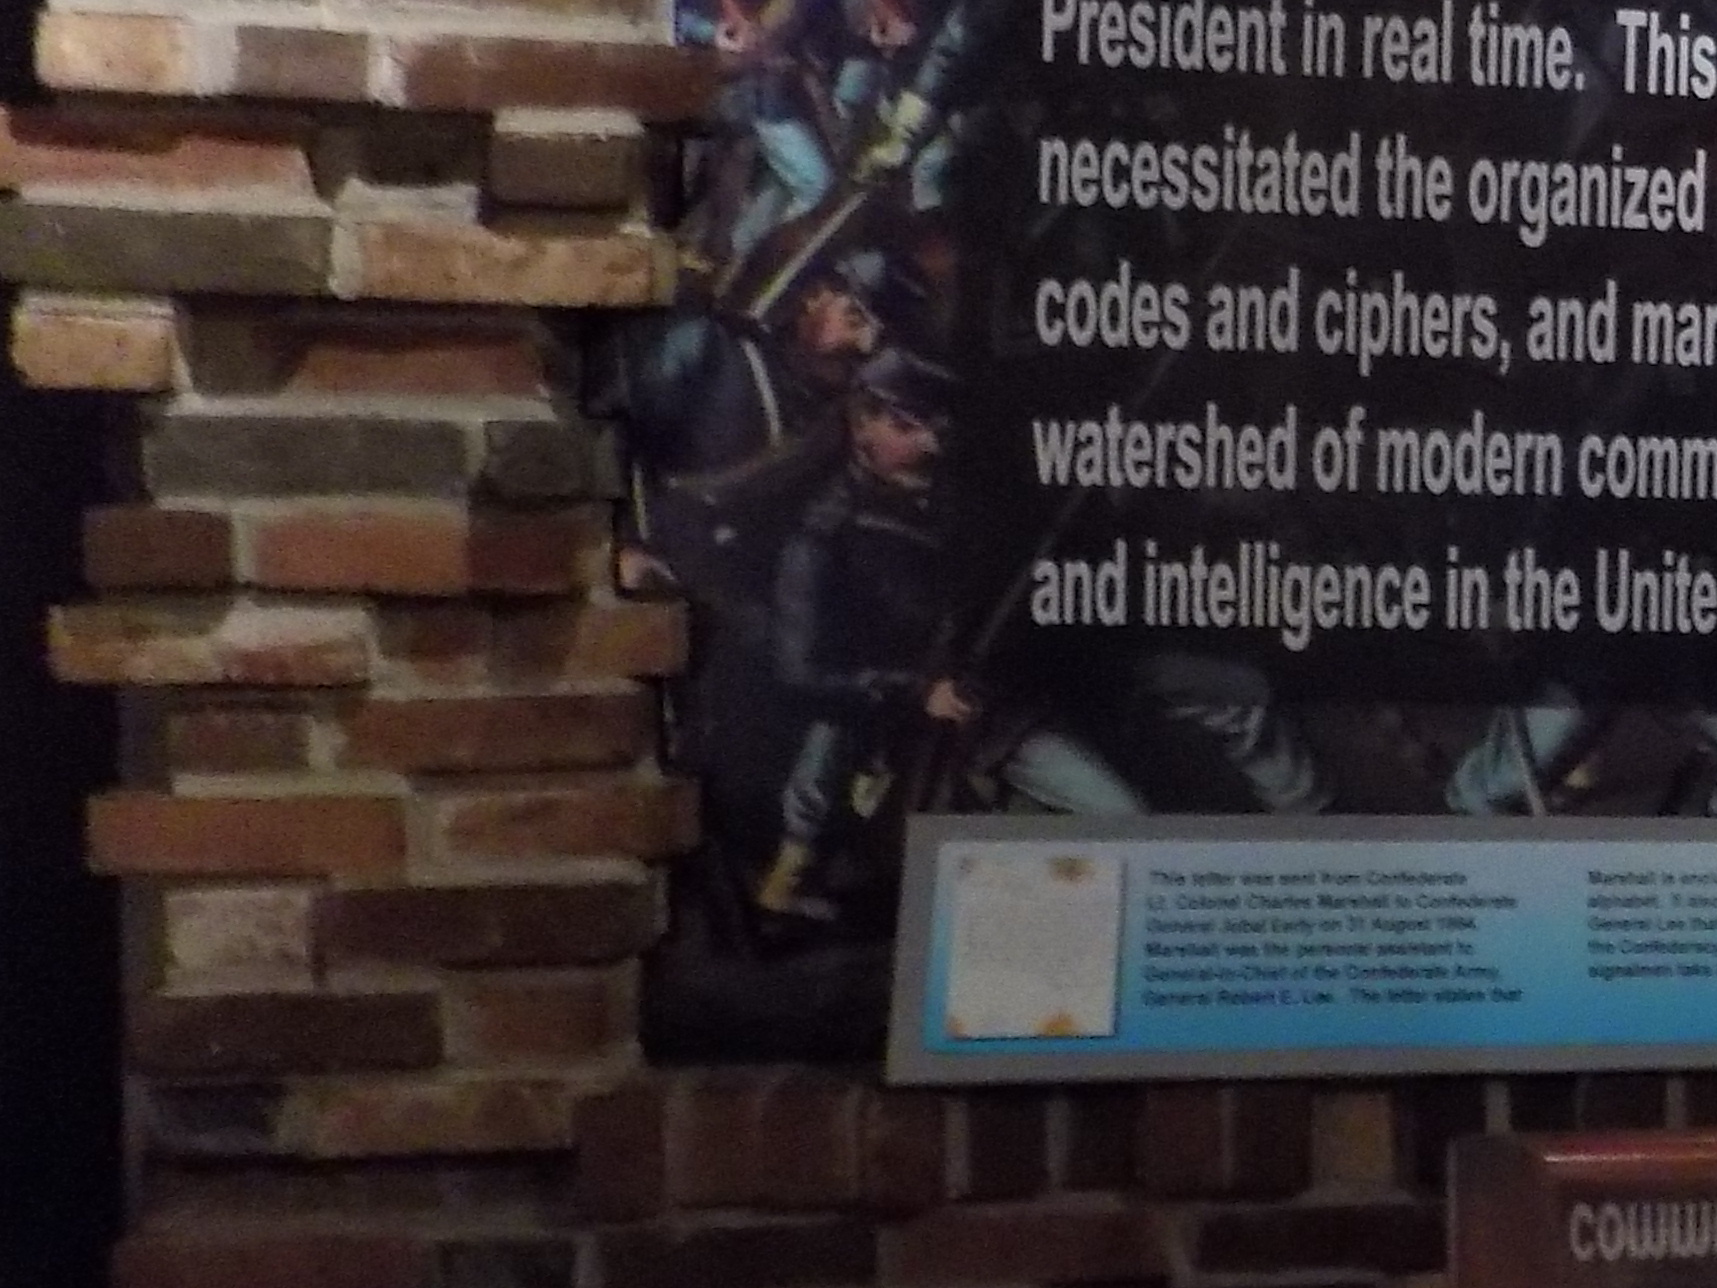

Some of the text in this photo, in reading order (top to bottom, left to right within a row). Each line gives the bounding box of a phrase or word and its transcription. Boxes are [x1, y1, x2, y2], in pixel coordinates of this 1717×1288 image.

[1470, 4, 1585, 92] time.
[1617, 9, 1717, 102] This
[1038, 124, 1359, 220] necessitated
[1377, 132, 1453, 223] the
[1468, 143, 1706, 248] organized
[1035, 261, 1190, 352] codes
[1207, 268, 1300, 356] and
[1315, 268, 1511, 377] ciphers,
[1527, 280, 1617, 364] and
[1033, 403, 1298, 492] watershed
[1312, 407, 1364, 492] of
[1378, 412, 1562, 496] modern
[1032, 540, 1128, 626] and
[1143, 542, 1430, 650] intelligence
[1446, 546, 1489, 631] in
[1505, 549, 1579, 632] the
